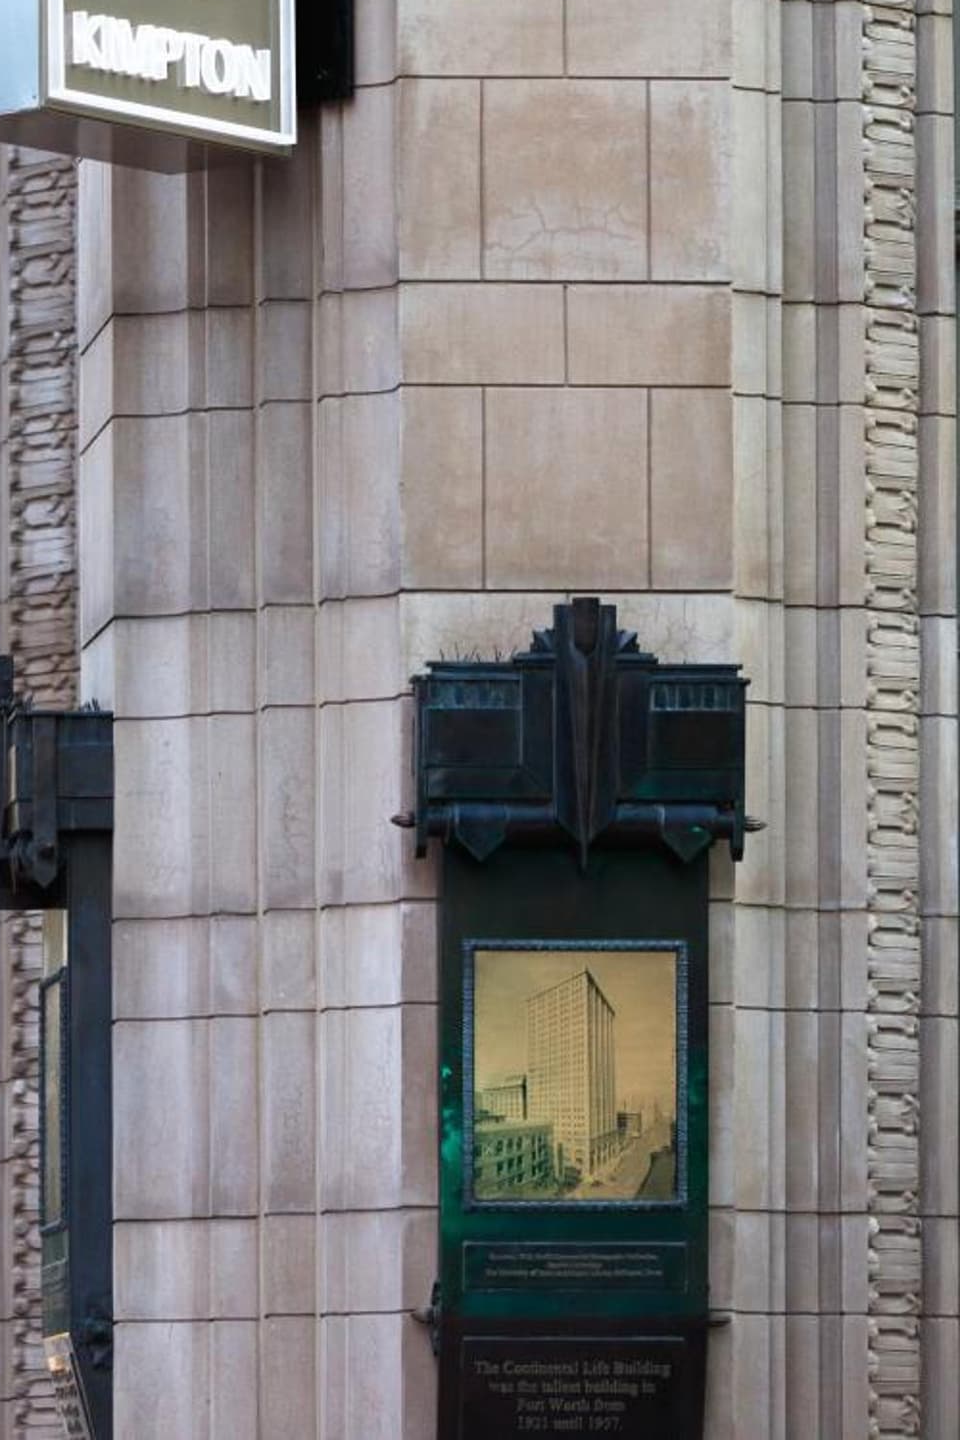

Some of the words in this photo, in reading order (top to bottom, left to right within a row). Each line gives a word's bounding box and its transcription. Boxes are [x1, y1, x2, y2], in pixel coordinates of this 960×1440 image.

[72, 10, 271, 101] KIMPTON
[475, 1361, 500, 1375] The
[613, 1361, 672, 1377] Building
[585, 1379, 639, 1396] building
[548, 1397, 591, 1412] Worth
